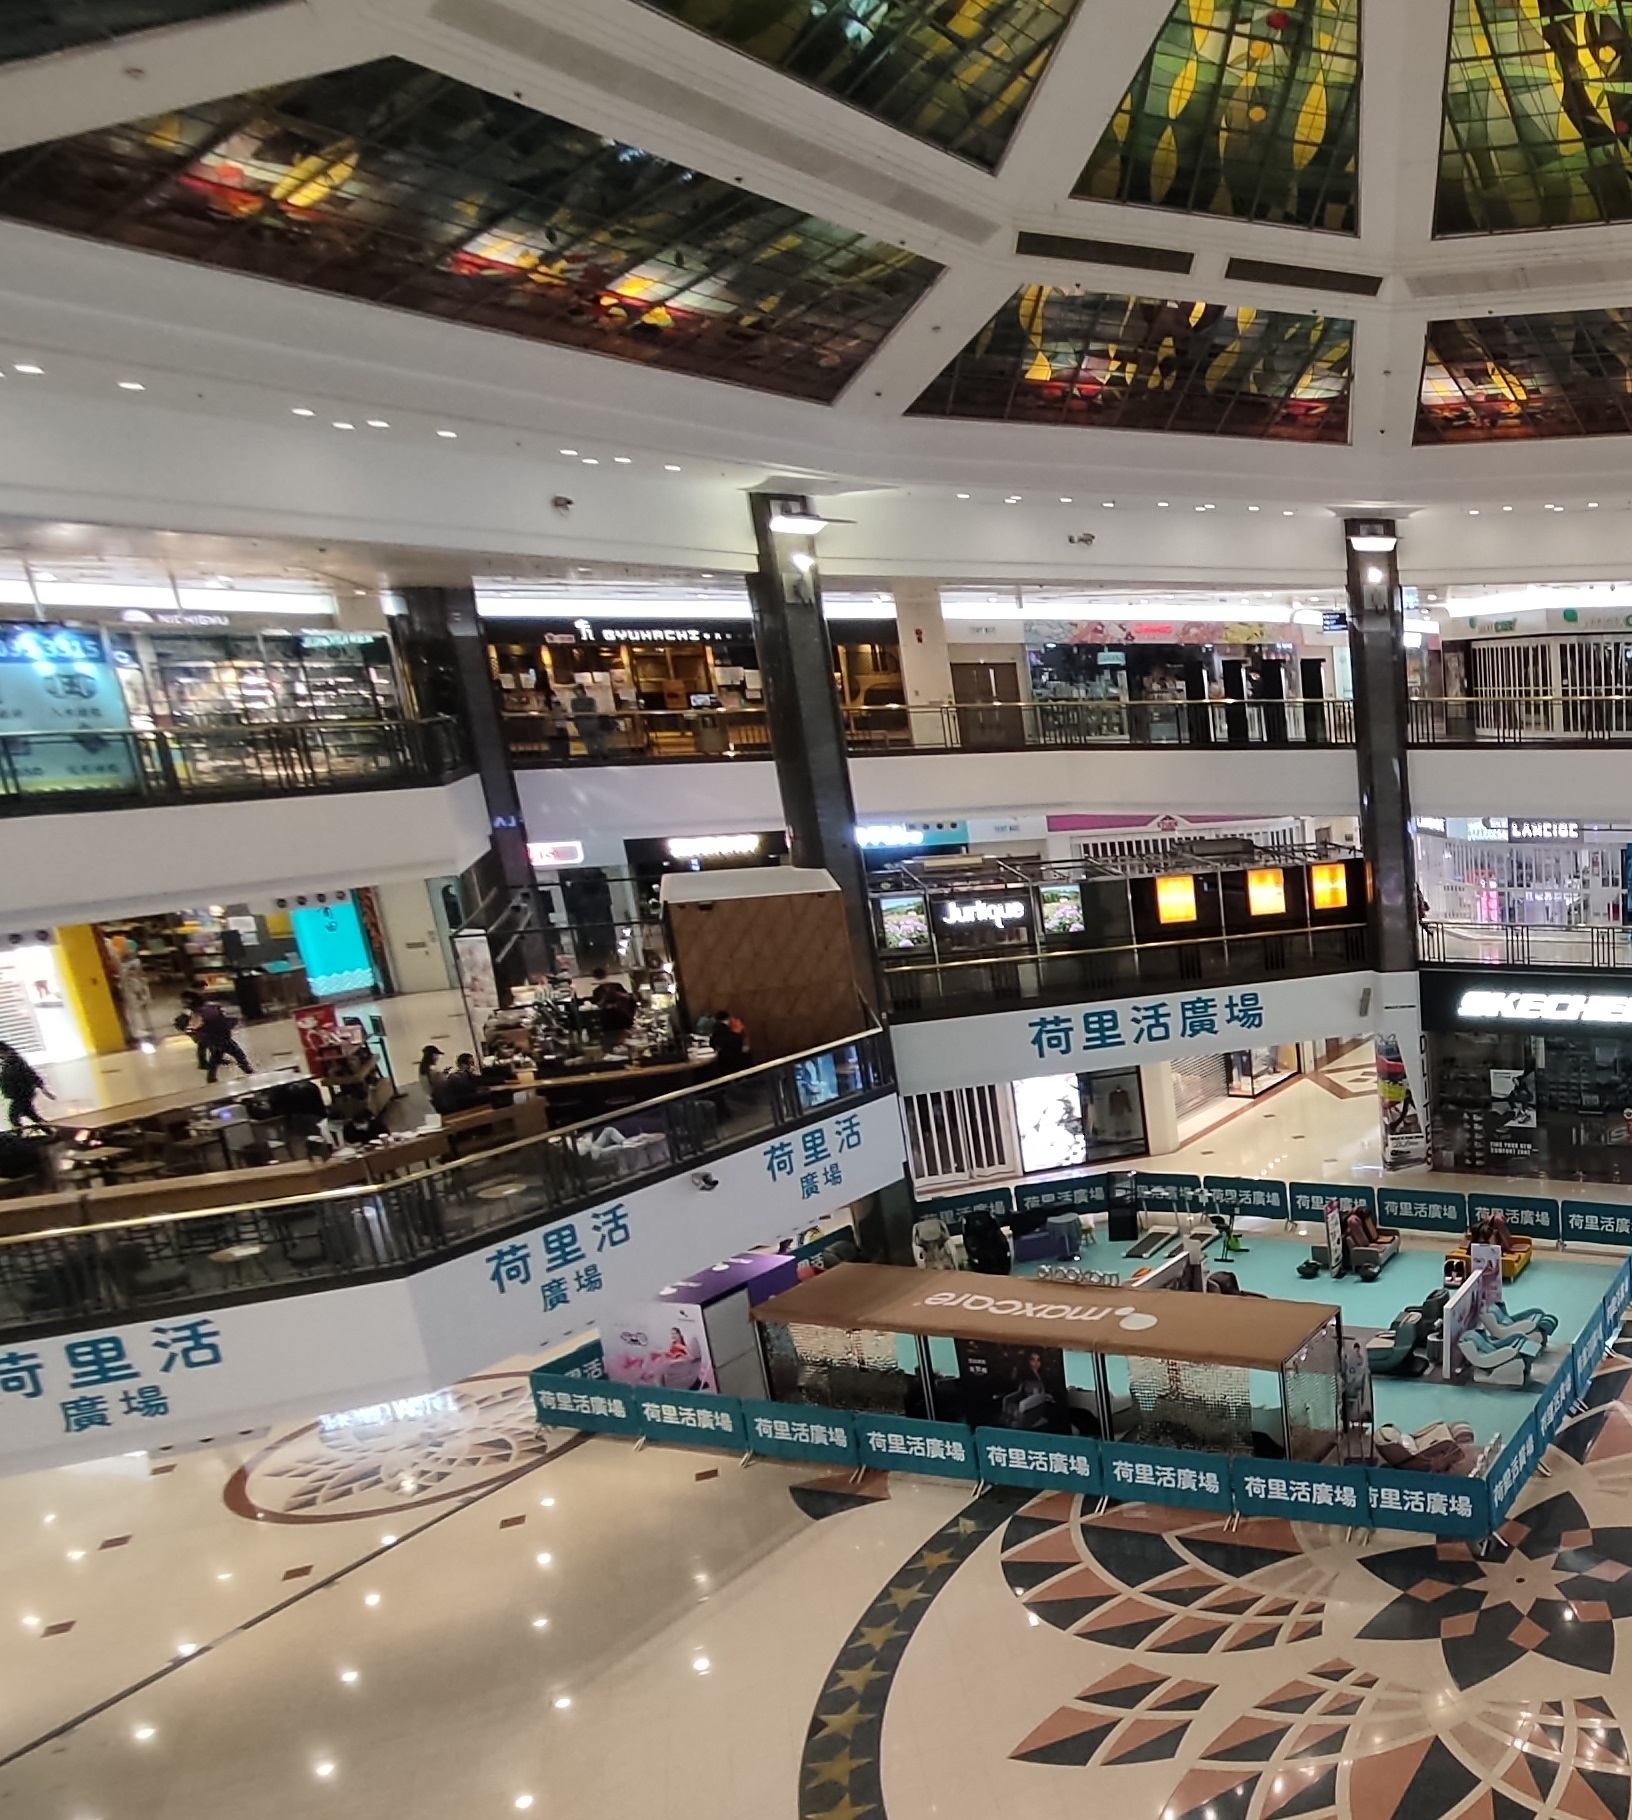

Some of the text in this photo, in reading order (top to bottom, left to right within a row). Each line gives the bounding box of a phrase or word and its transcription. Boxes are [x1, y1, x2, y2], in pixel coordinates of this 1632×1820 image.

[943, 902, 1025, 929] Jurlique
[1028, 993, 1264, 1058] 荷里活廣場
[764, 1114, 862, 1181] 荷里活
[800, 1162, 842, 1200] 廣場
[1385, 1201, 1457, 1220] 荷里活廣場
[486, 1203, 632, 1293] 荷里活
[540, 1264, 603, 1312] 廣場
[924, 1291, 1117, 1321] maxcare
[59, 1385, 169, 1433] 廣場
[537, 1389, 627, 1419] 荷里活廣場
[642, 1402, 733, 1433] 荷里活廣場
[754, 1416, 848, 1449] 荷里活廣場
[866, 1431, 966, 1462] 荷里活廣場
[987, 1445, 1091, 1478] 荷里活廣場
[1113, 1459, 1220, 1495] 荷里活廣場
[1245, 1475, 1357, 1509] 荷里活廣場
